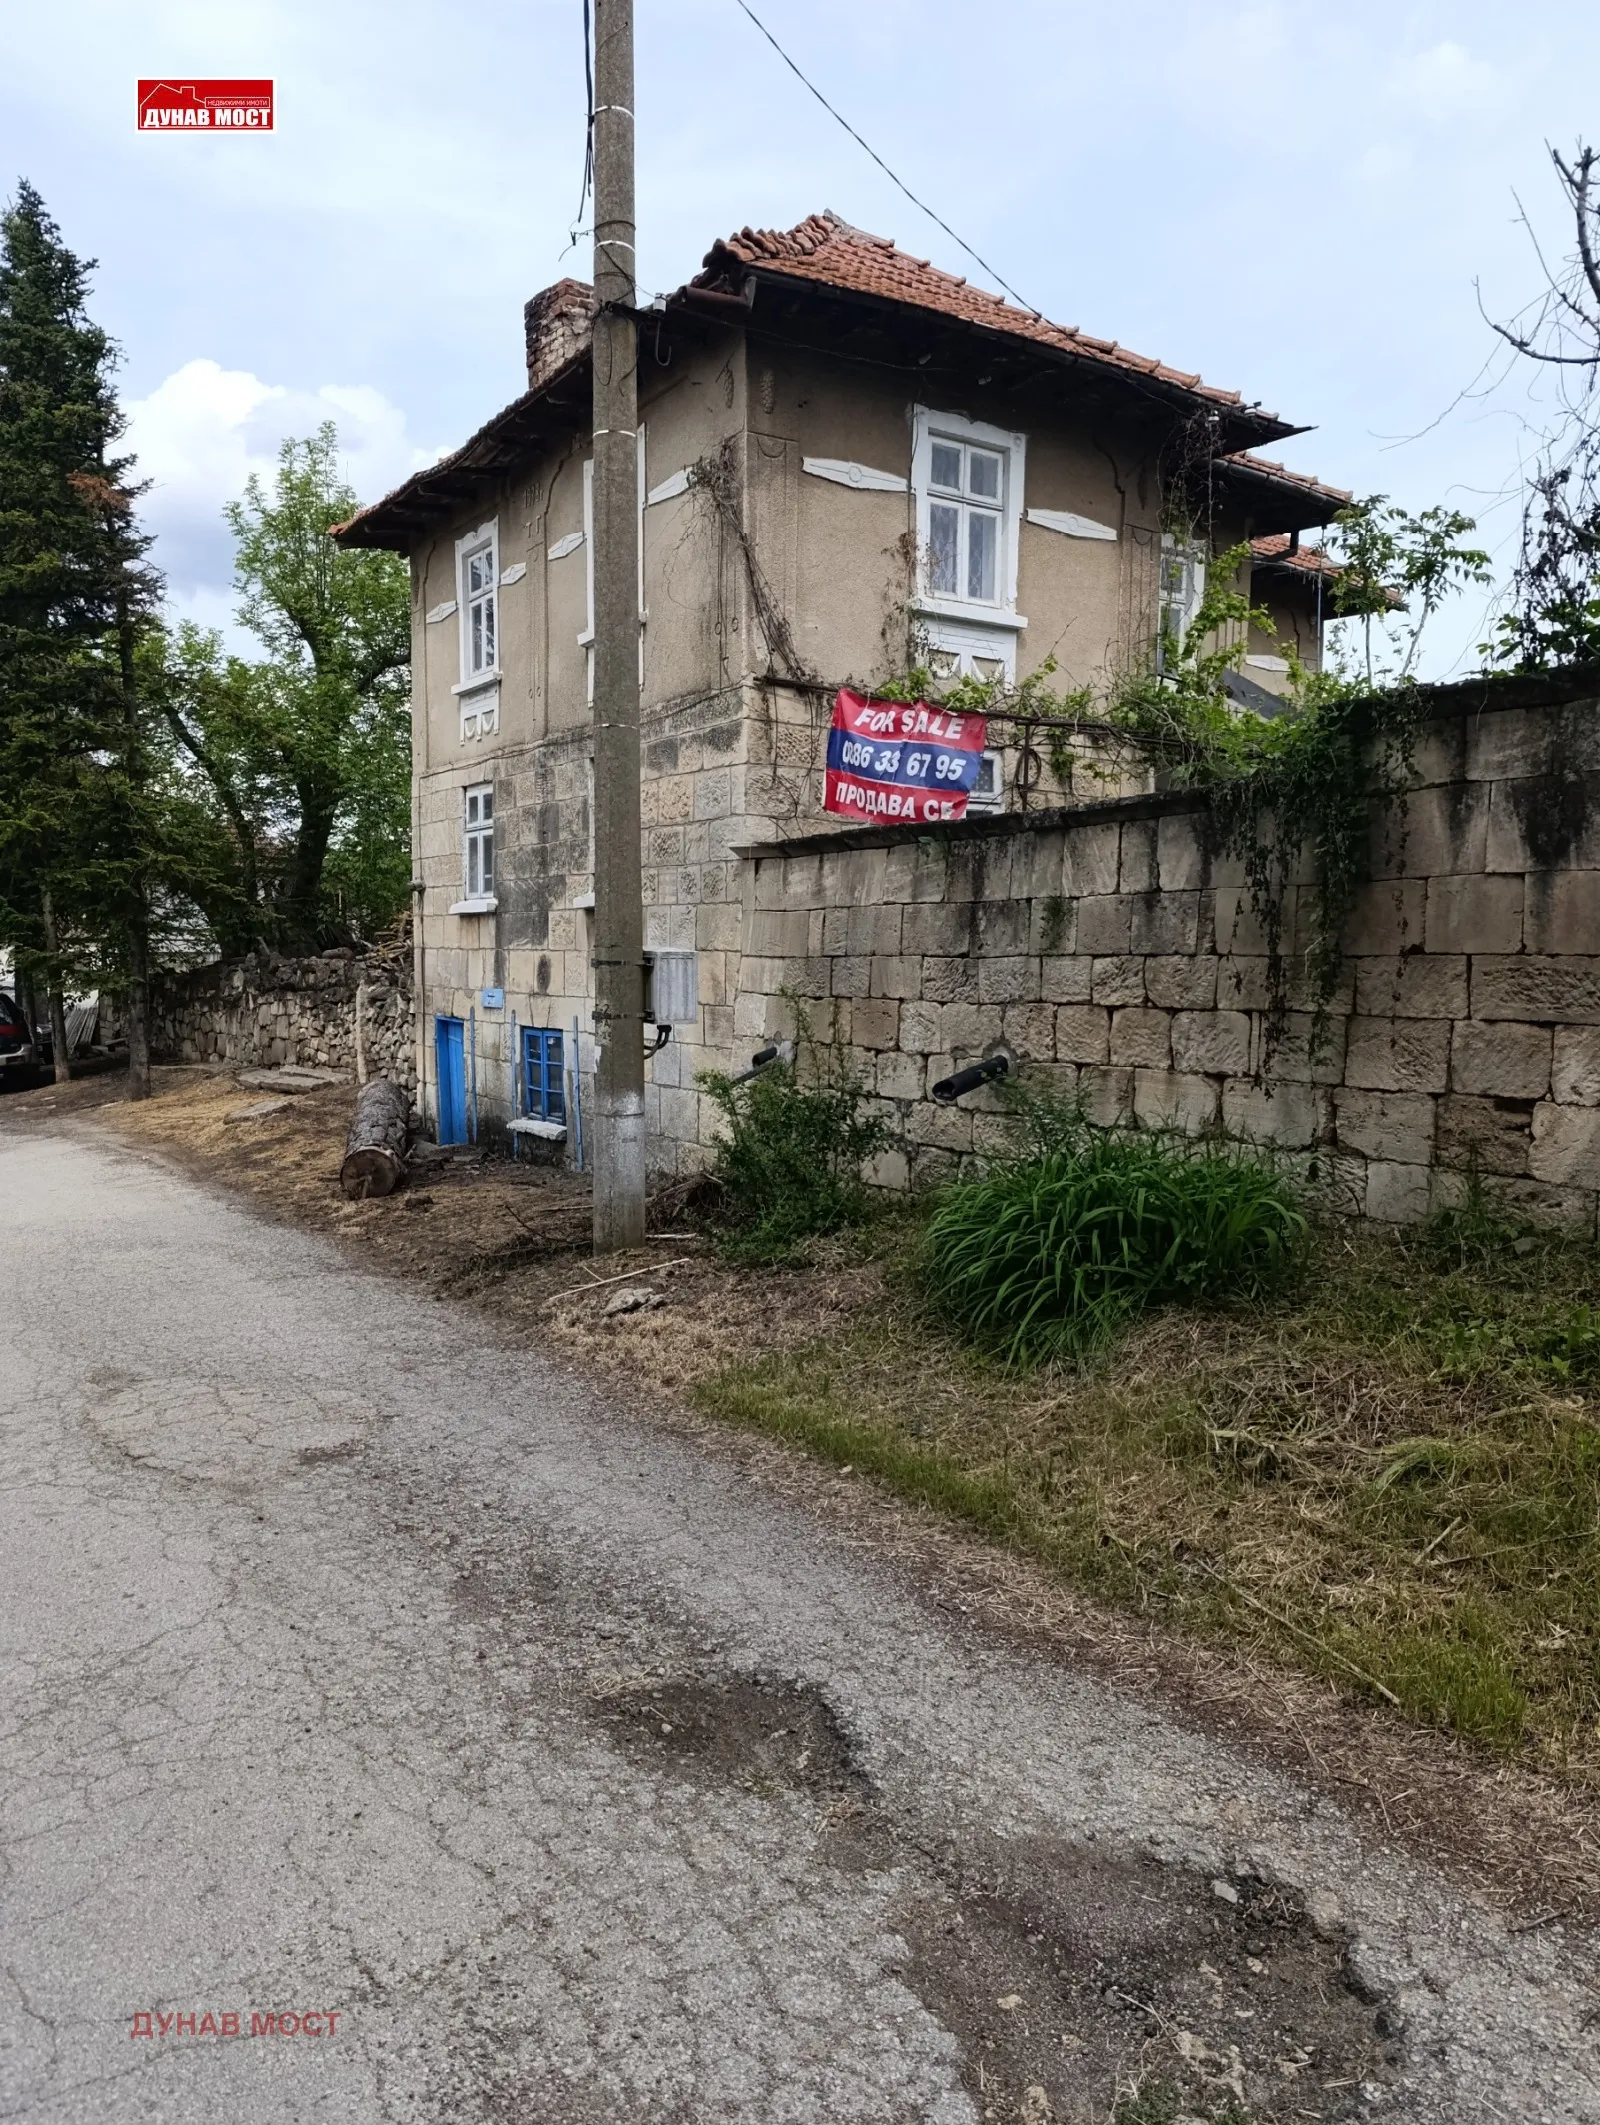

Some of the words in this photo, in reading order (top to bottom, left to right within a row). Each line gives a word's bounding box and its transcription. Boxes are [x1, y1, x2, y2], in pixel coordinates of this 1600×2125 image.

[854, 708, 896, 733] FOR
[901, 709, 966, 740] SALE
[874, 750, 901, 773] 33
[906, 752, 932, 778] 67
[935, 755, 967, 781] 95
[835, 781, 917, 819] ПРОДАВА
